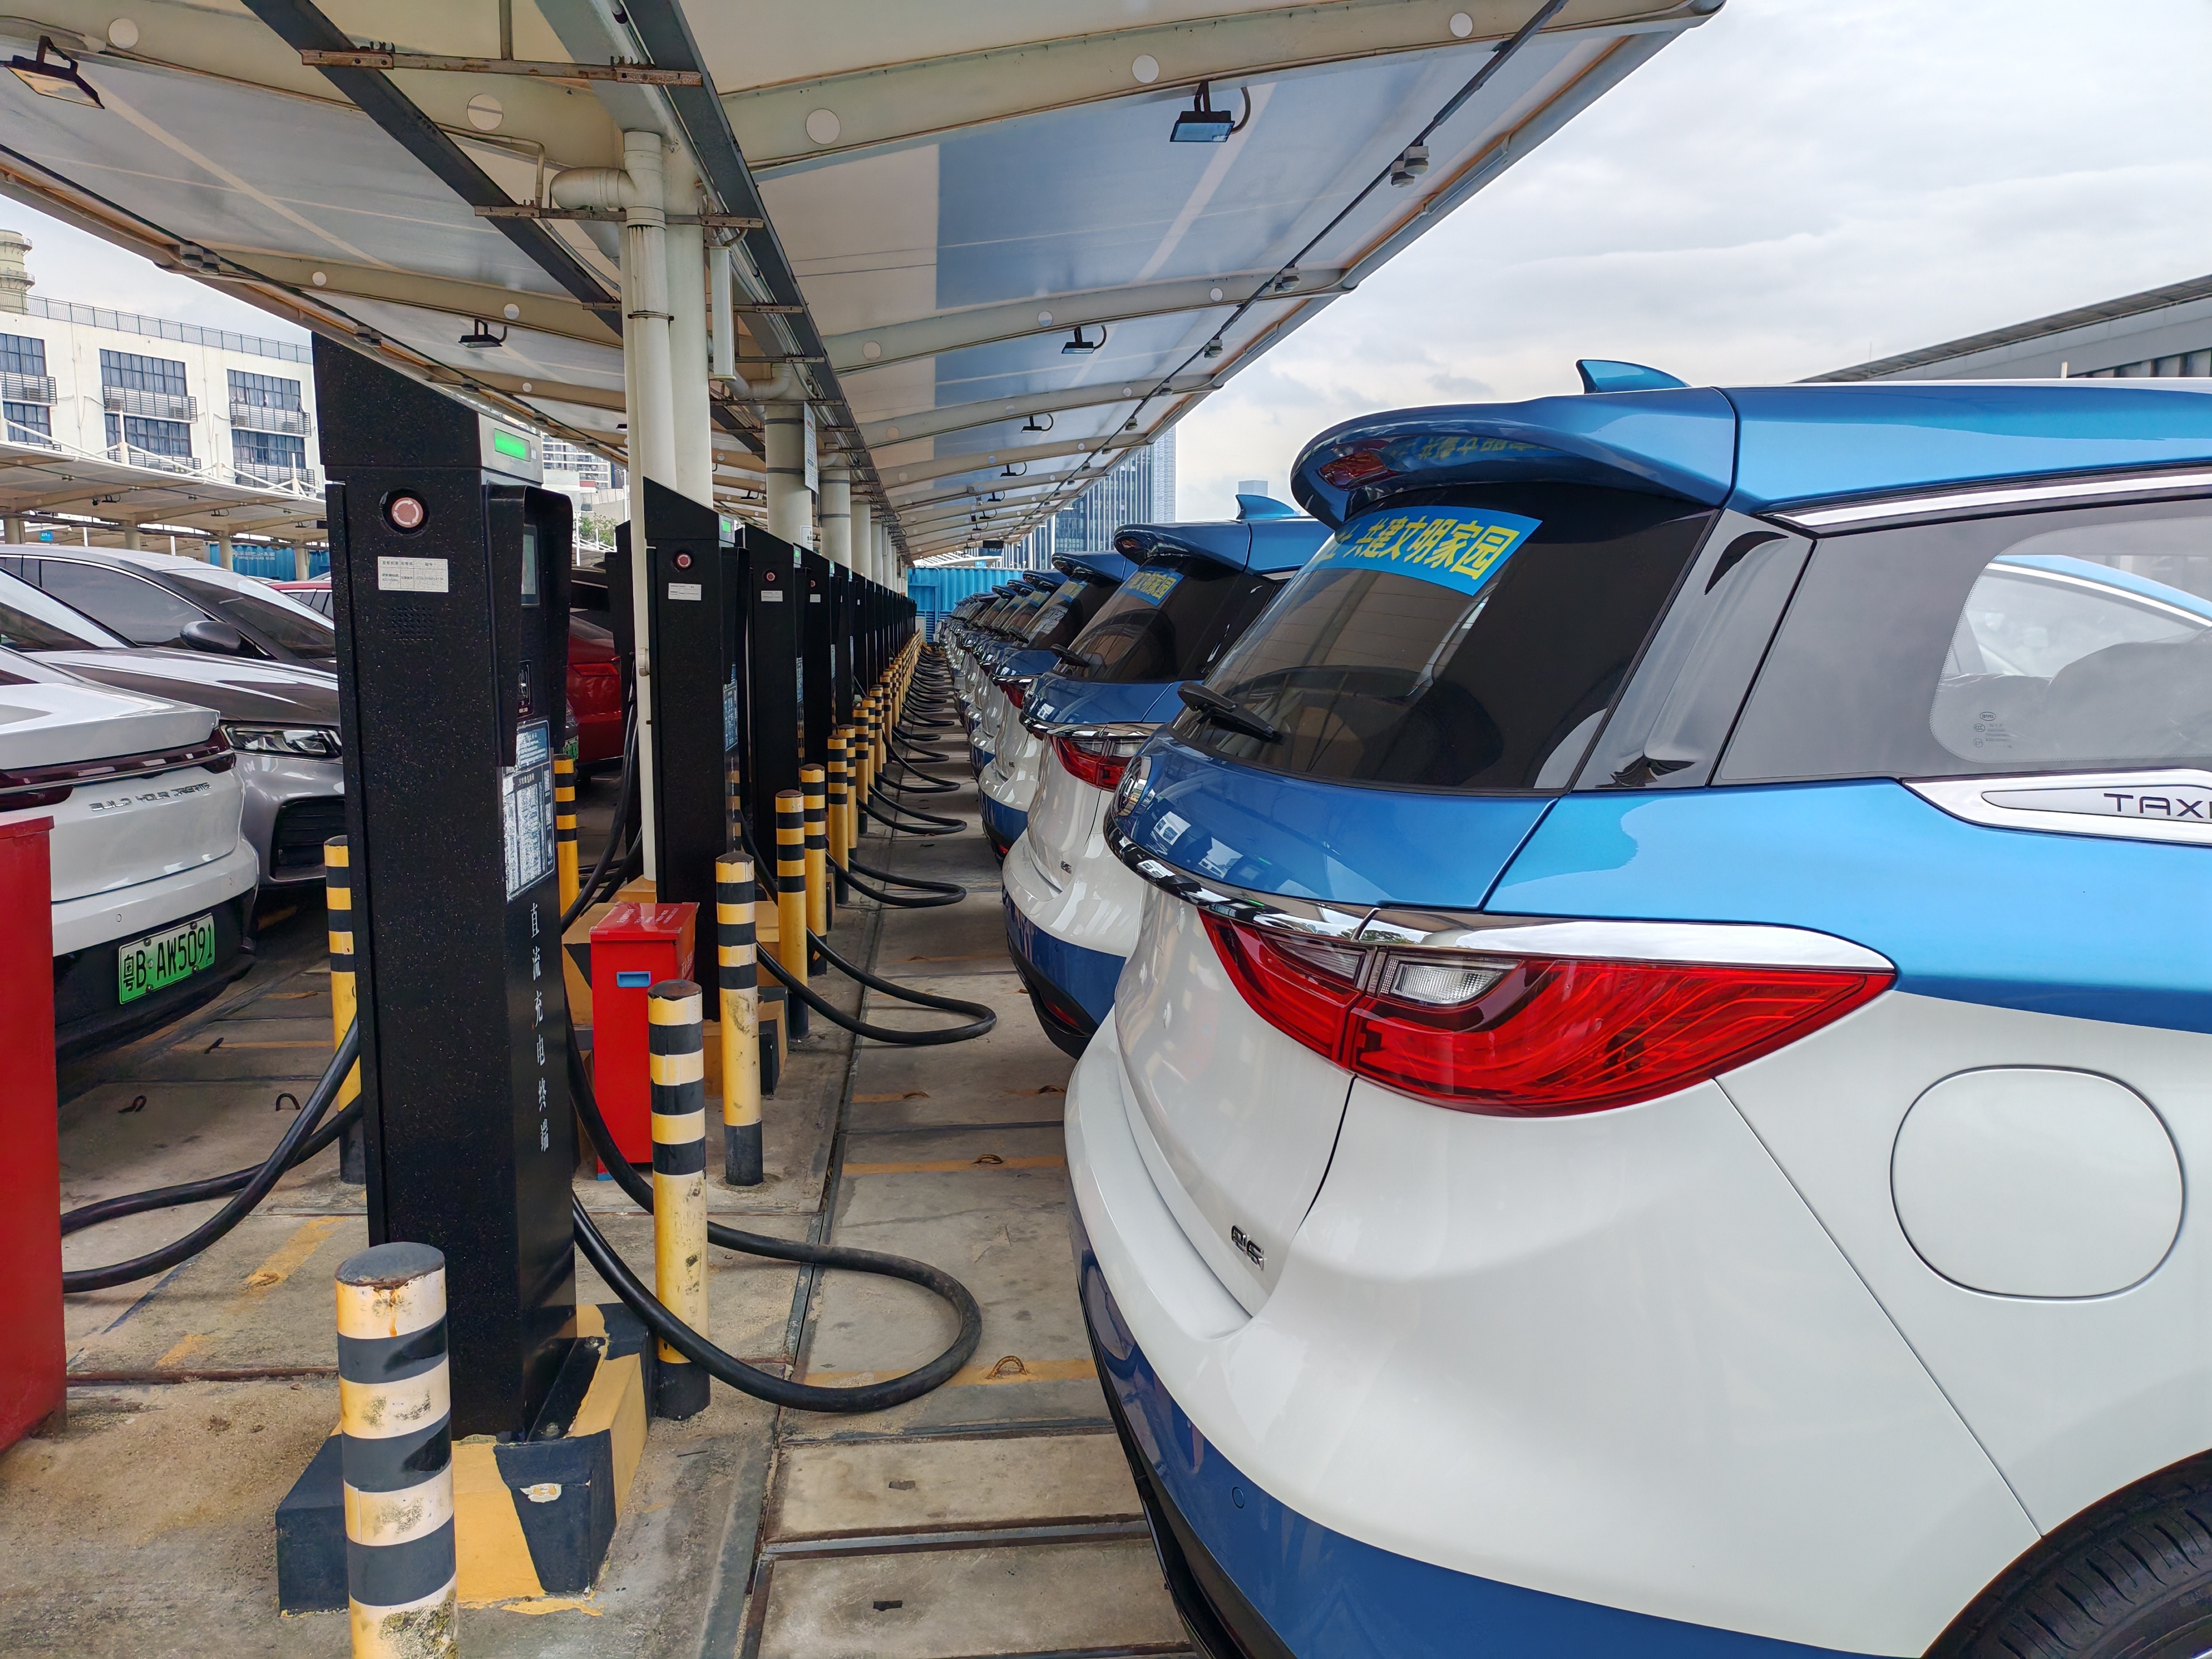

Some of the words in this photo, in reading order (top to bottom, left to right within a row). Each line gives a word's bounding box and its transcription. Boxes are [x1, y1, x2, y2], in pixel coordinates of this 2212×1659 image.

[1343, 515, 1520, 580] 共建文明家园
[89, 798, 132, 811] BUILD
[136, 791, 171, 802] YOUR
[2103, 793, 2212, 819] TAXI
[530, 902, 549, 1152] 直流充电终端
